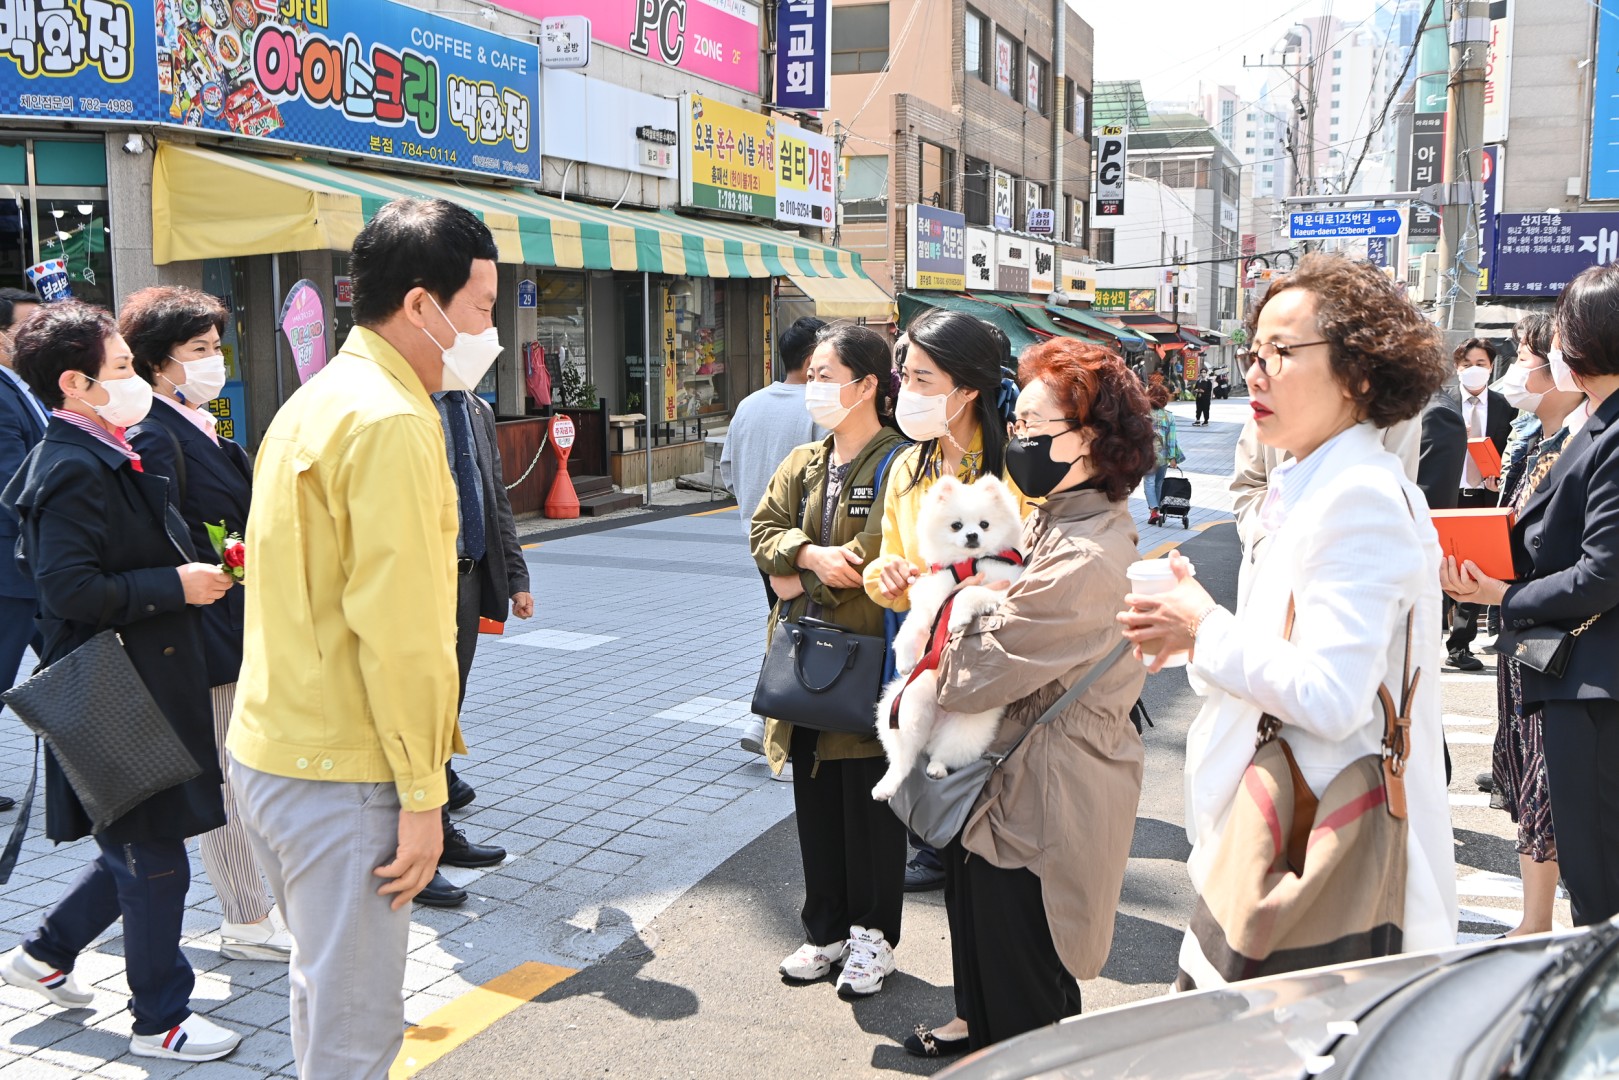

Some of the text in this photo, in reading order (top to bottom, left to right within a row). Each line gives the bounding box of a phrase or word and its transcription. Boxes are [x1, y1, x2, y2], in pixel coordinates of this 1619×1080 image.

[629, 0, 742, 66] PC ZONE 2F
[411, 27, 527, 75] COFFEE & CAFE
[252, 22, 440, 139] 아이스크림
[20, 95, 133, 112] 체인점문의 782-4988
[448, 73, 530, 153] 백화점
[369, 135, 457, 162] 본점 784-0114
[694, 122, 774, 172] 오복 혼수 이불 커텐
[711, 165, 728, 186] 홈패션
[779, 140, 832, 193] 쉼터 기원
[1416, 145, 1436, 224] 아리움
[717, 189, 753, 213] T:783-3164
[1103, 204, 1117, 214] 2F
[1294, 213, 1371, 227] 해운대로123번길
[1338, 226, 1377, 235] 123beon-gil
[1520, 214, 1562, 227] 산지직송
[943, 225, 964, 260] 전문점
[41, 276, 69, 301] 부라보
[1503, 282, 1567, 291] 포장 배달 예약
[524, 294, 531, 305] 29
[850, 507, 870, 515] ANYW
